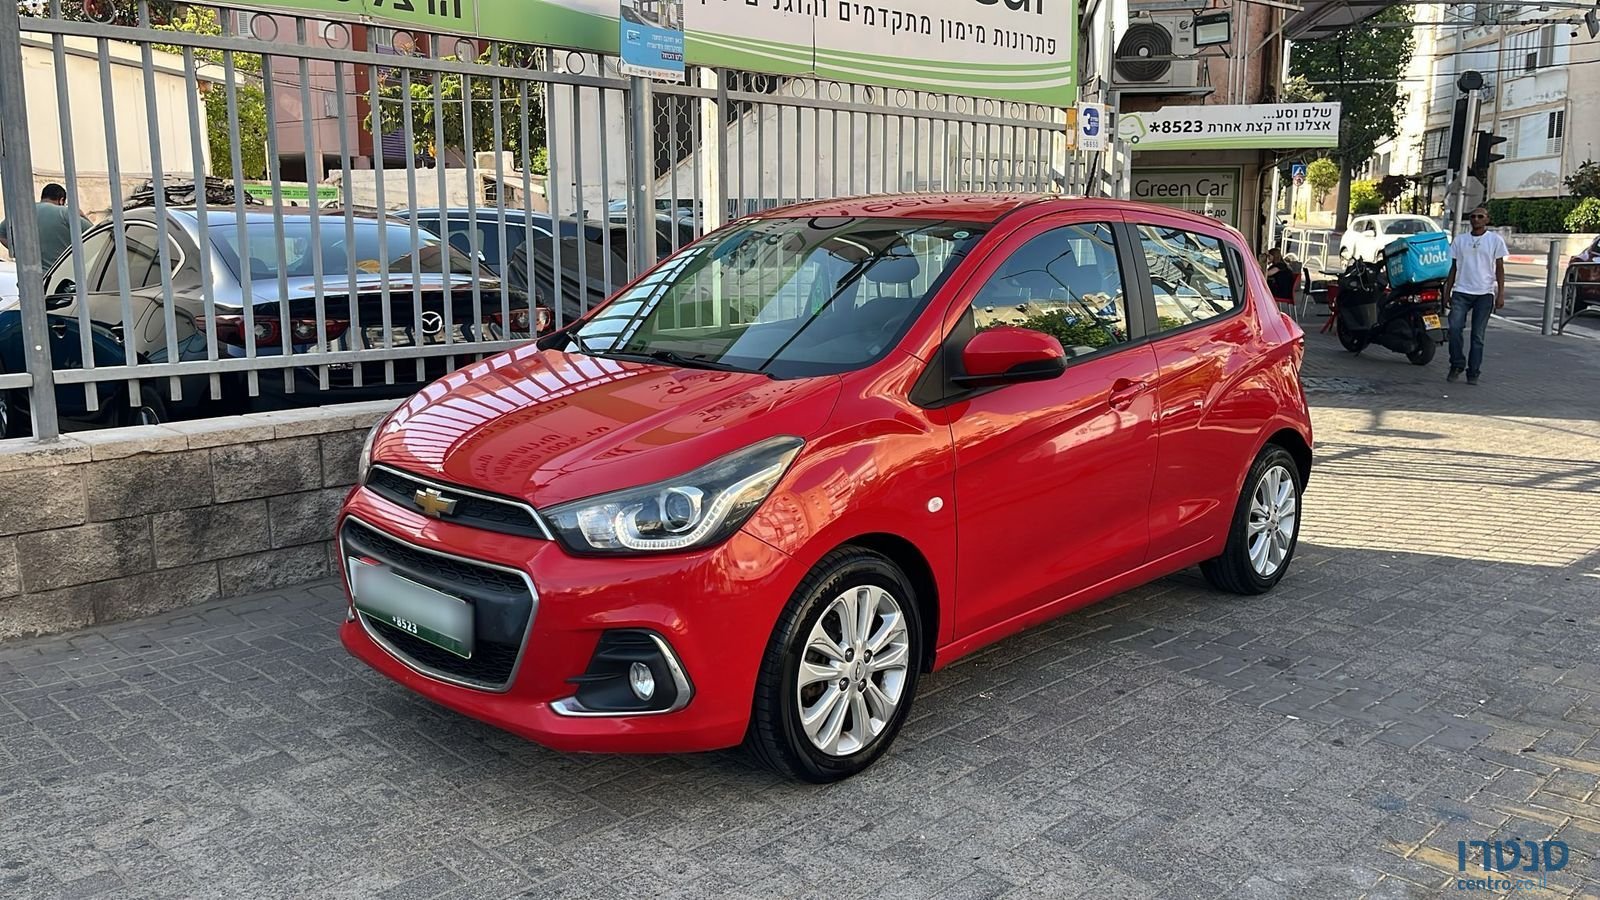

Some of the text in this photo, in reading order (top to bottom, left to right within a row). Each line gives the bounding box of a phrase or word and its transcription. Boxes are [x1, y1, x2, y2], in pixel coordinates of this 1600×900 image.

[745, 0, 1056, 55] פתרונות מימון מתקדמים והוג
[1263, 107, 1332, 119] שלם וסע...
[1083, 108, 1100, 136] 3
[1207, 122, 1243, 133] אחרת
[1245, 120, 1273, 134] קצת
[1276, 120, 1292, 131] זה
[1295, 119, 1331, 131] אצלנו
[1135, 179, 1229, 197] Green Car
[1419, 251, 1448, 266] Wolt
